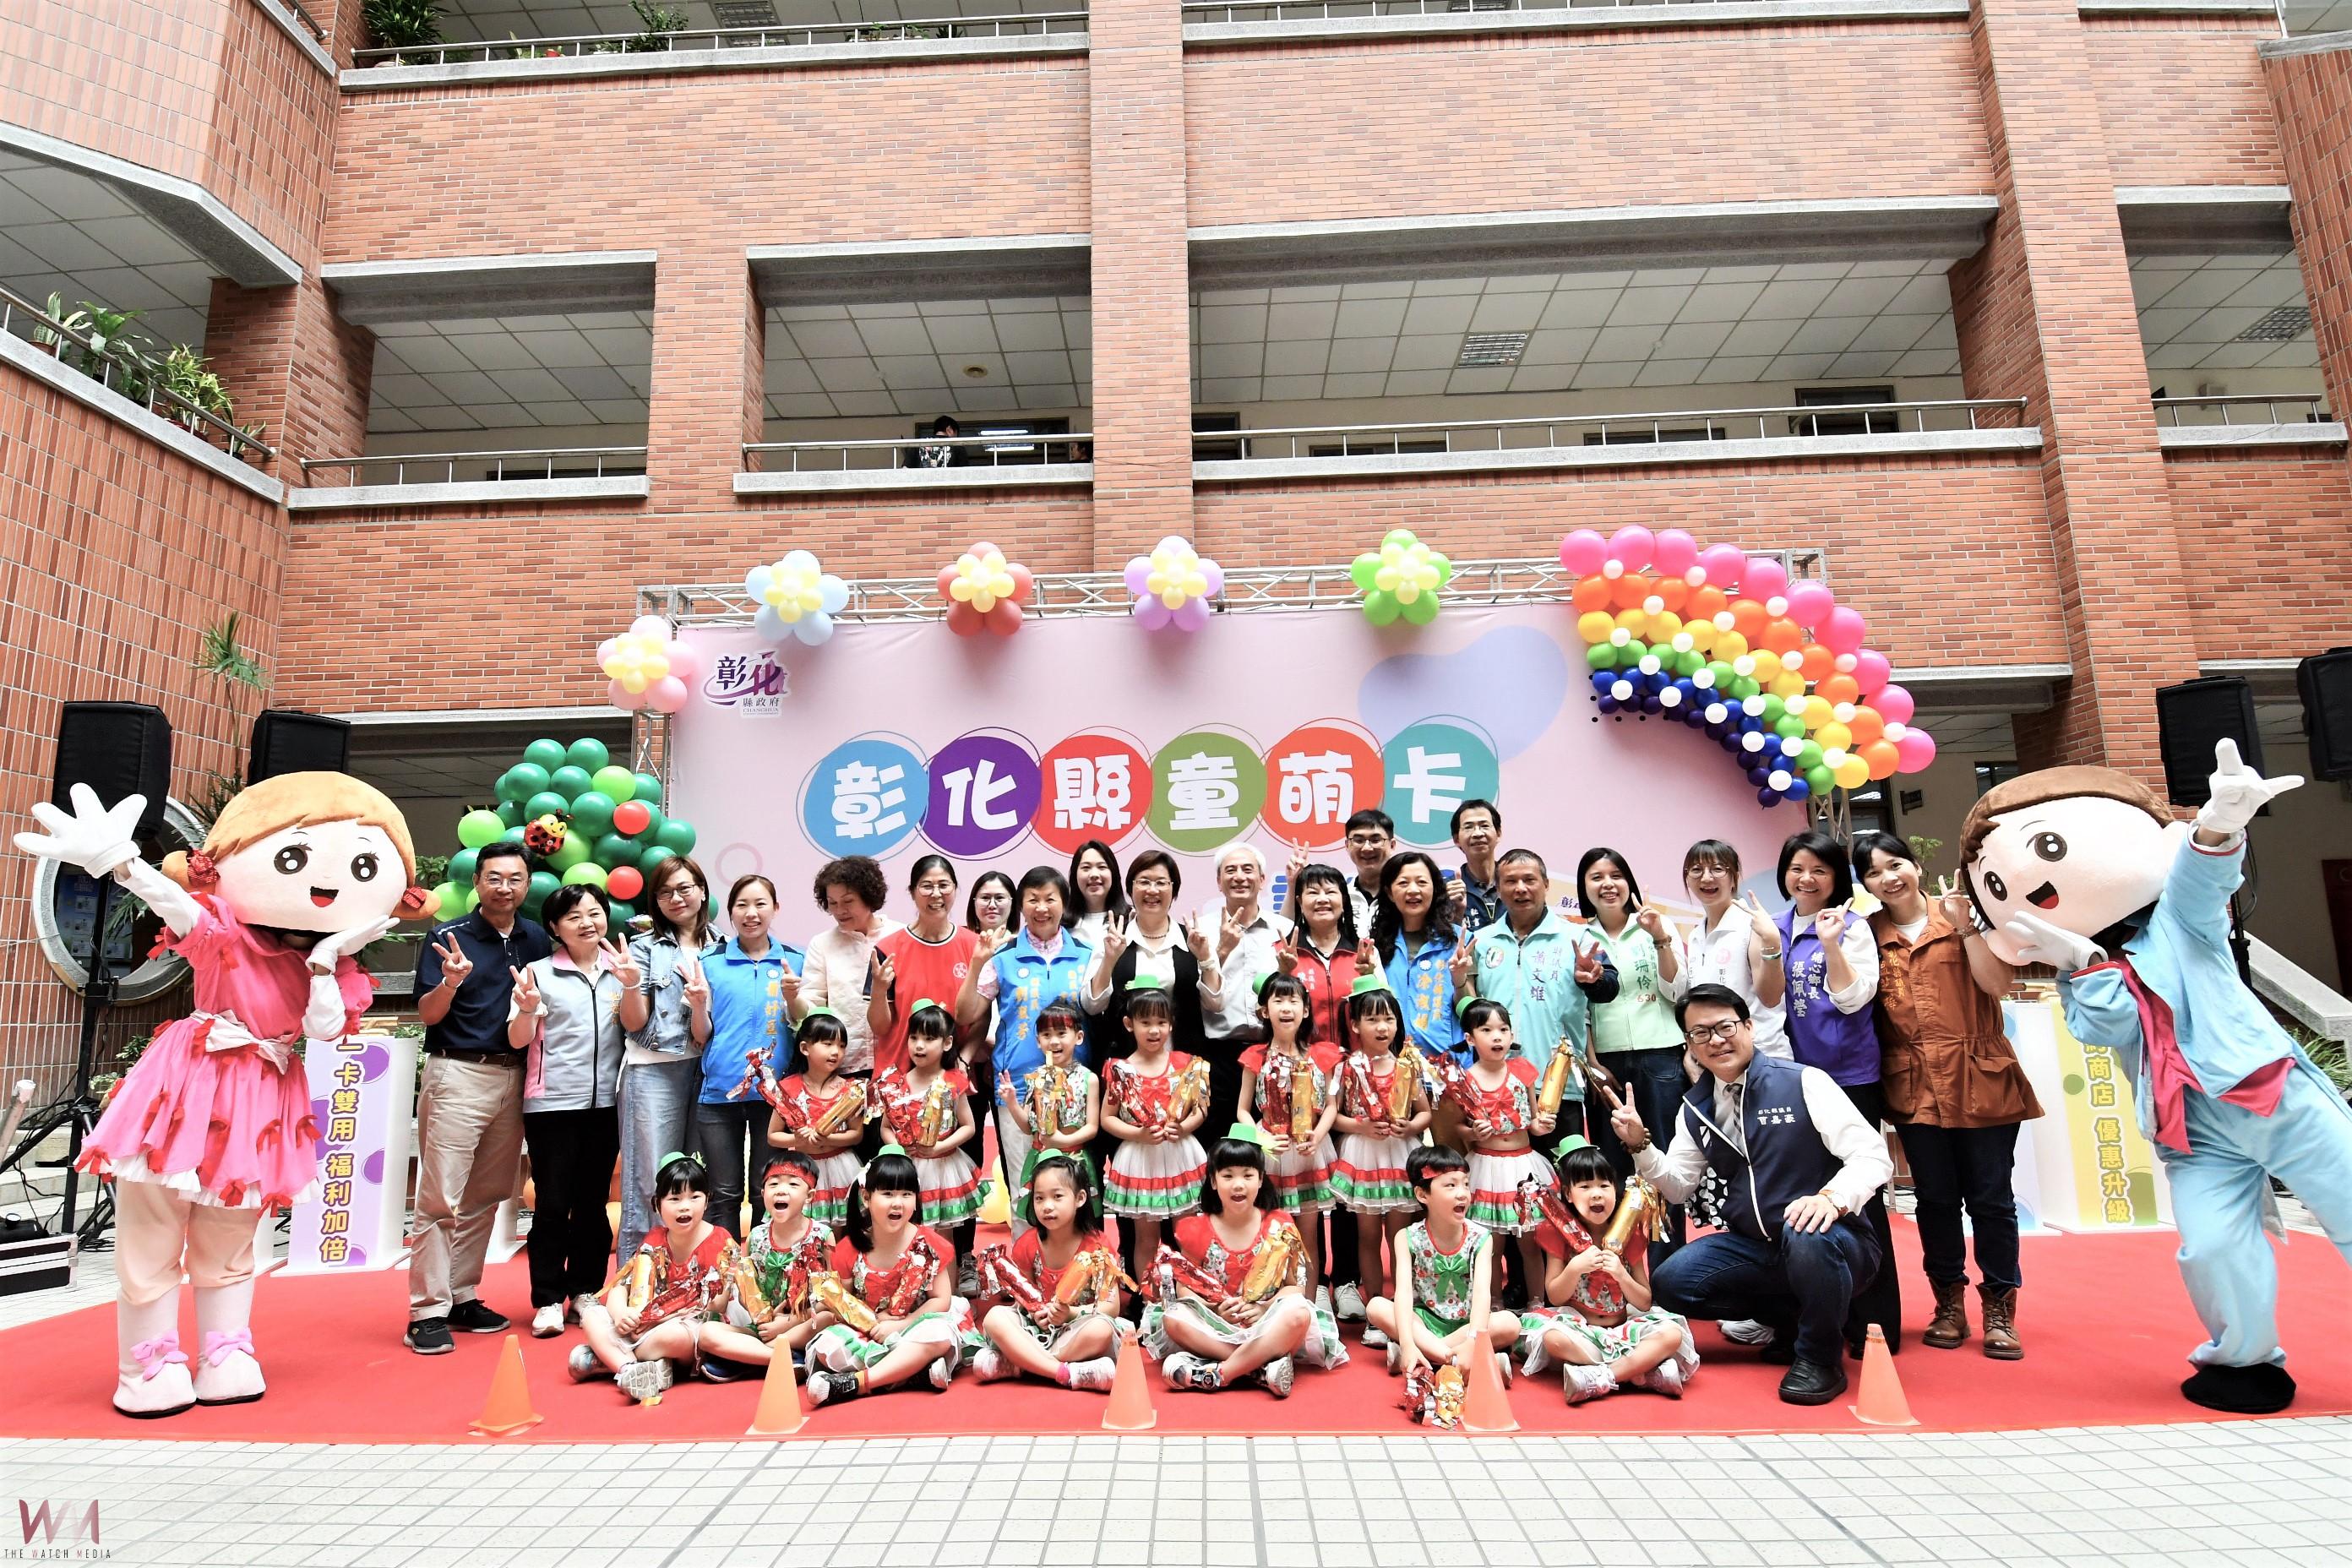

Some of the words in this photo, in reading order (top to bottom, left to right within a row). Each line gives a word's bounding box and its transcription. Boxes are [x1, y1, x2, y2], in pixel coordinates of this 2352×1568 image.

[716, 656, 781, 697] 彰化
[743, 697, 779, 708] 縣政府
[830, 745, 1467, 840] 彰化縣童萌卡
[329, 1043, 363, 1142] 一卡雙用
[320, 1152, 354, 1263] 福利加倍
[2096, 1118, 2131, 1224] 優惠升級
